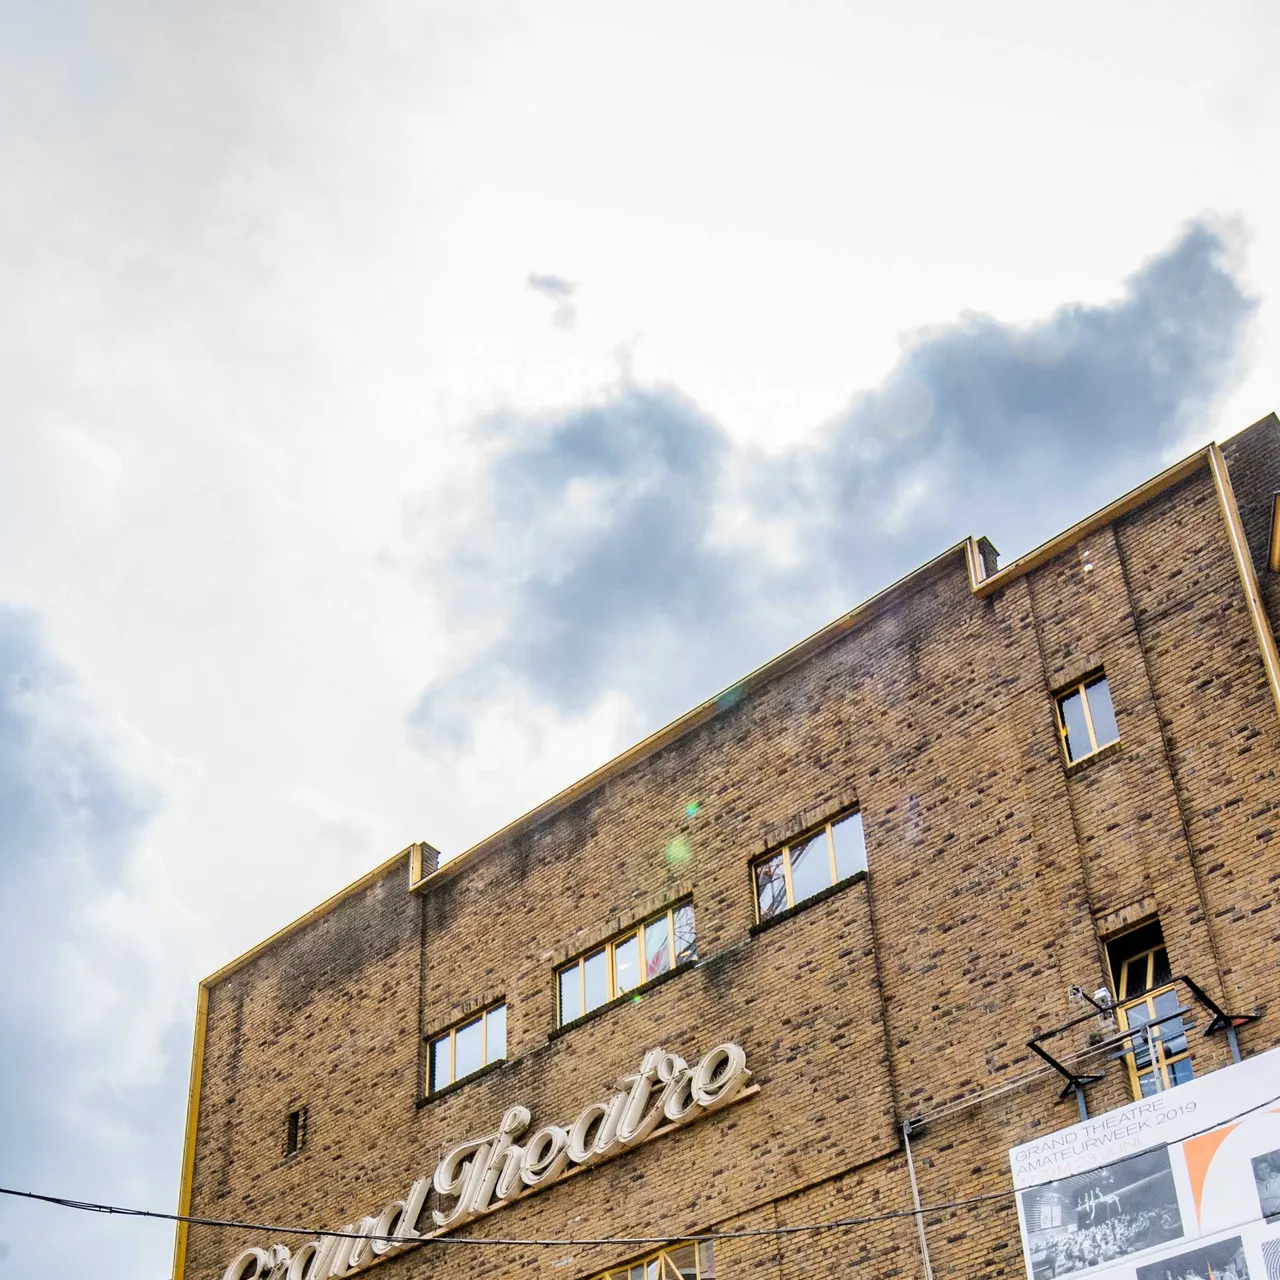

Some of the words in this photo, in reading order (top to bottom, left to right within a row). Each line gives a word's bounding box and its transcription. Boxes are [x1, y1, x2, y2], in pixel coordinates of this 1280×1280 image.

[432, 1042, 754, 1229] Theatre
[1015, 1132, 1078, 1162] GRAND
[1082, 1098, 1166, 1134] THEATRE
[1016, 1119, 1152, 1176] AMATEURWEEK
[1155, 1101, 1197, 1125] 2019
